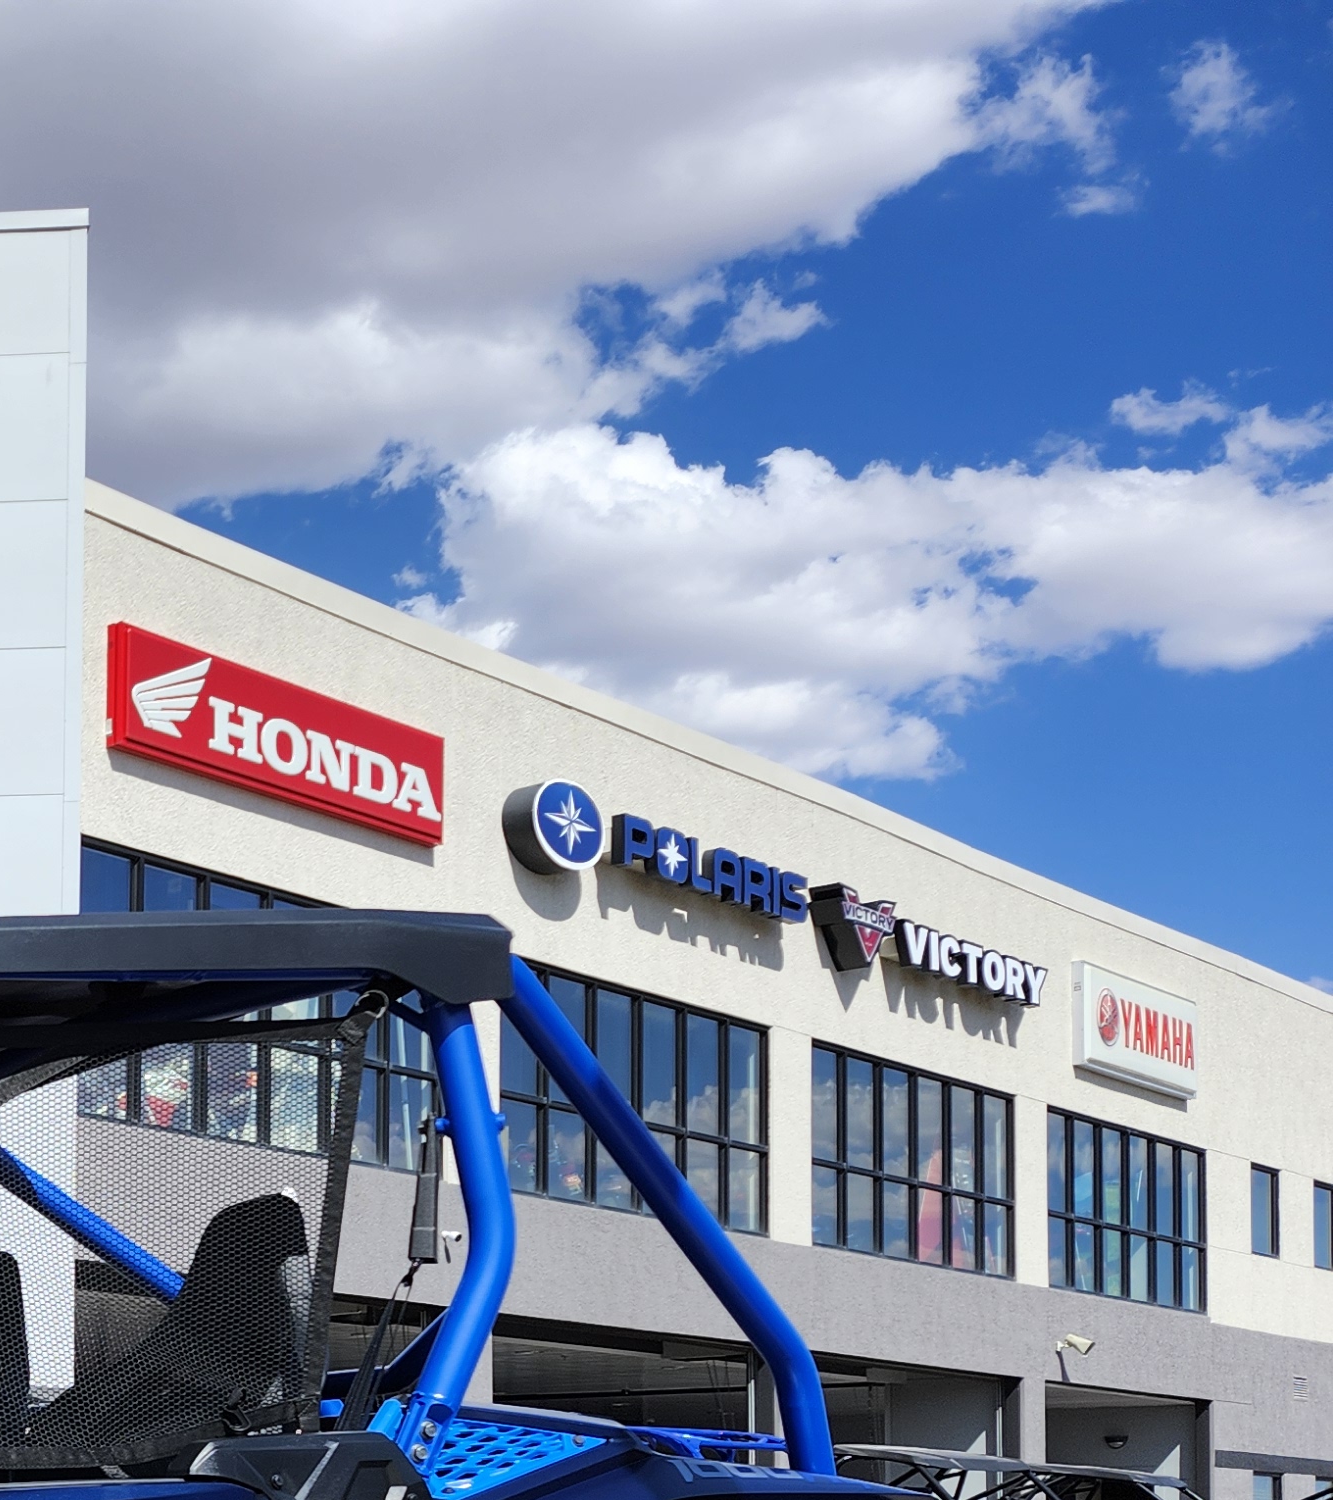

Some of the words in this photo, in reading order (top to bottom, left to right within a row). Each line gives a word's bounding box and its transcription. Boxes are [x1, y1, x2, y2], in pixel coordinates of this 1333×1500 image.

[208, 696, 442, 821] HONDA
[613, 812, 808, 924] POLARIS
[843, 902, 895, 932] VICTORY
[901, 919, 1048, 1006] VICTORY
[1120, 998, 1194, 1071] YAMAHA
